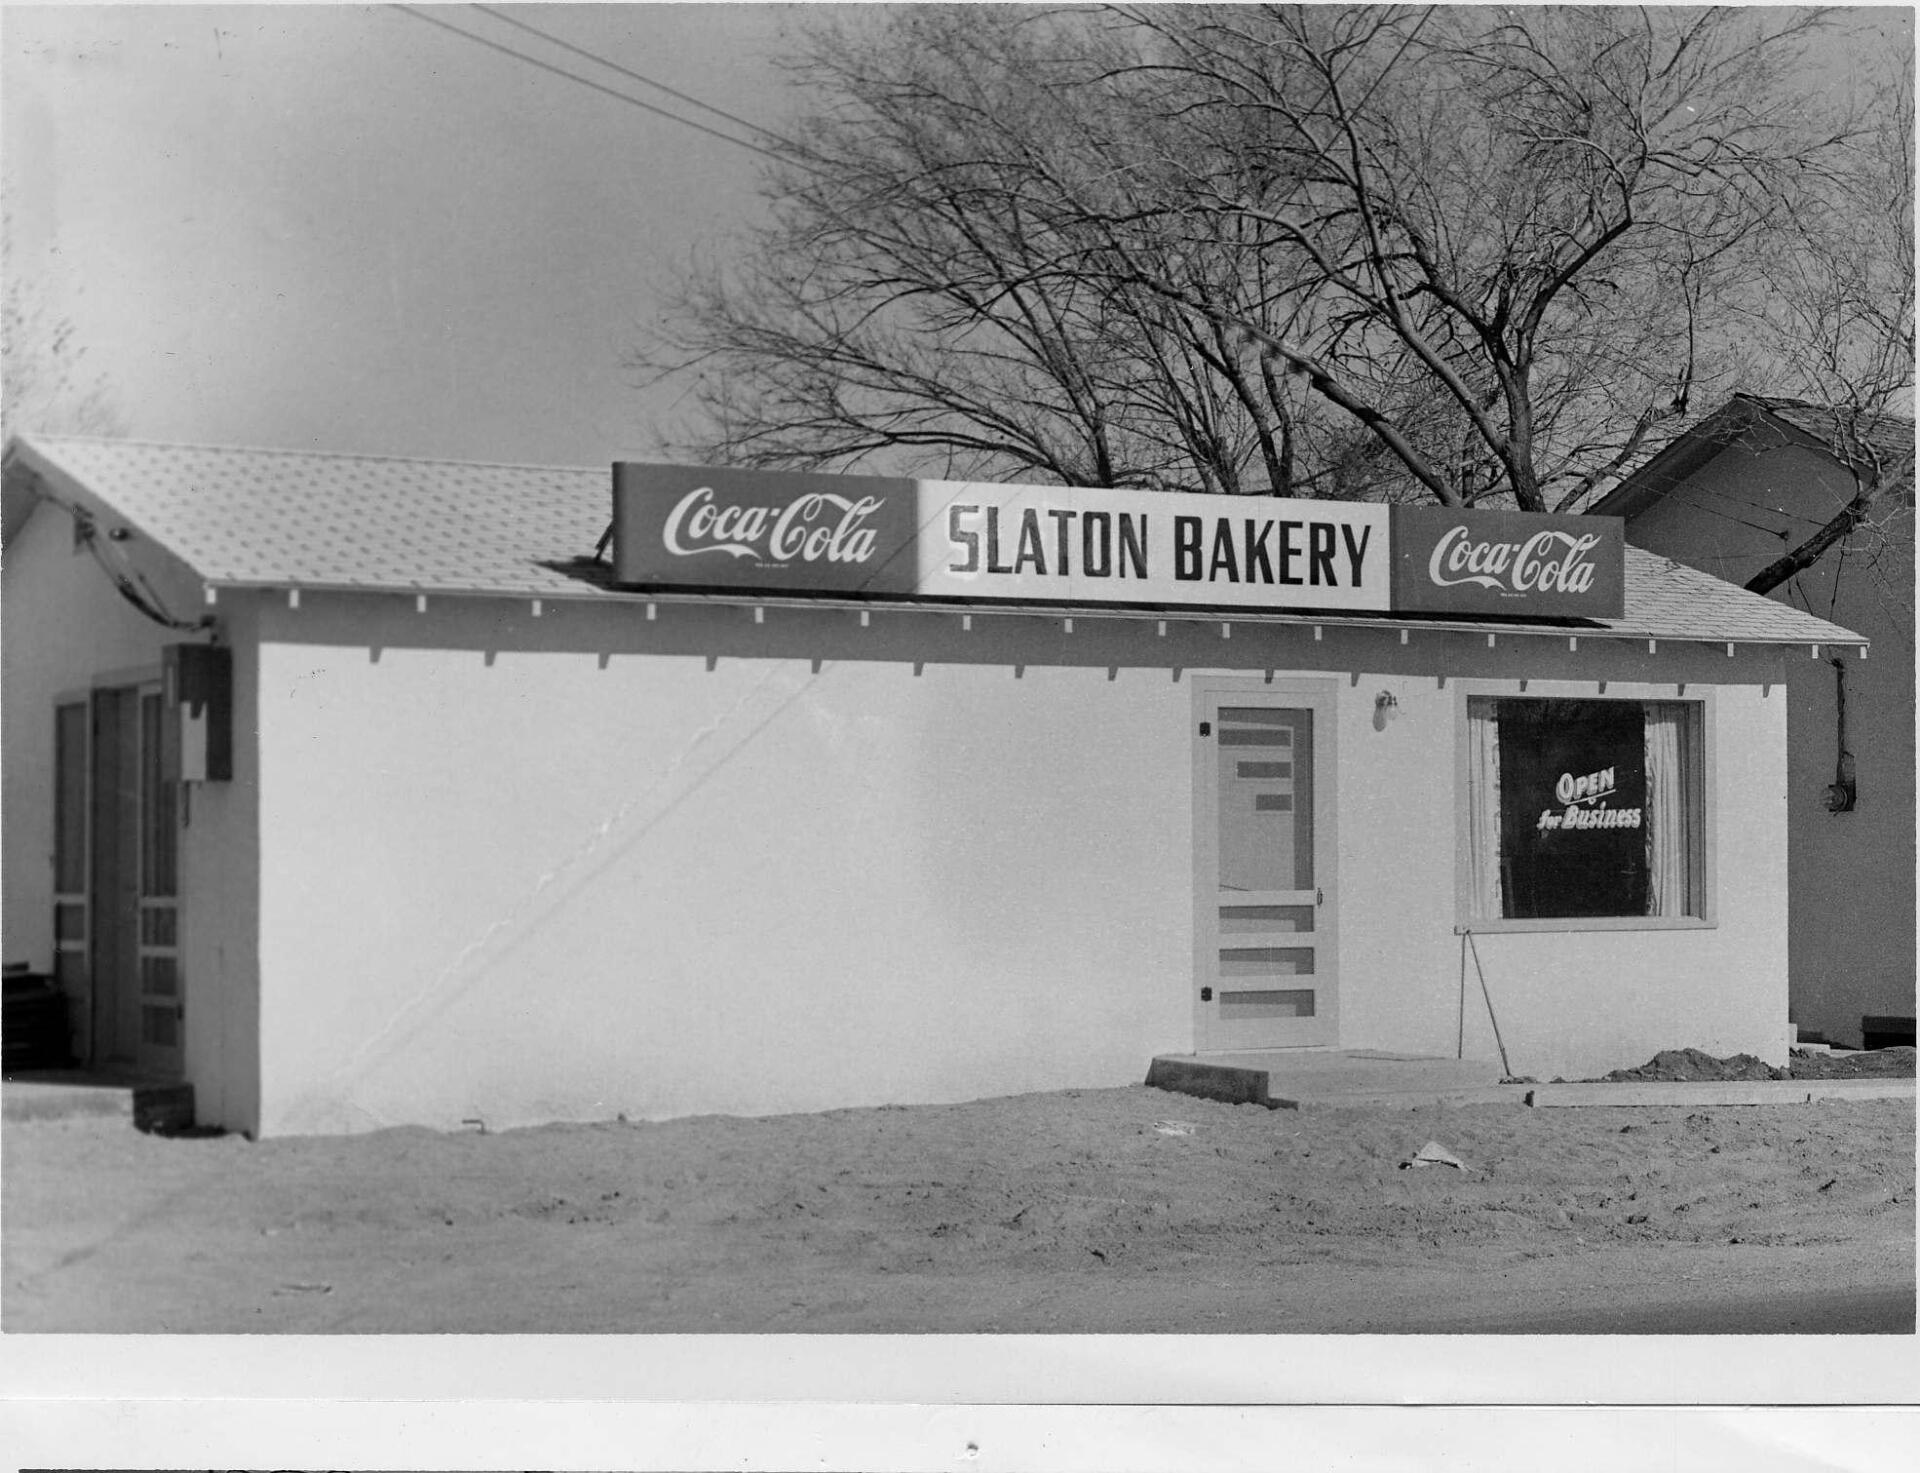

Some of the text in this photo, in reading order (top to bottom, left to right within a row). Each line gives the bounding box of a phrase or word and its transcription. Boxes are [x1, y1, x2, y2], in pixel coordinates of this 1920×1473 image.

[663, 487, 886, 562] Coca-Cola
[949, 504, 1372, 587] SLATON BAKERY
[1429, 525, 1601, 593] Coca-Cola
[1536, 801, 1641, 836] for Business
[1556, 766, 1614, 804] OPEN
